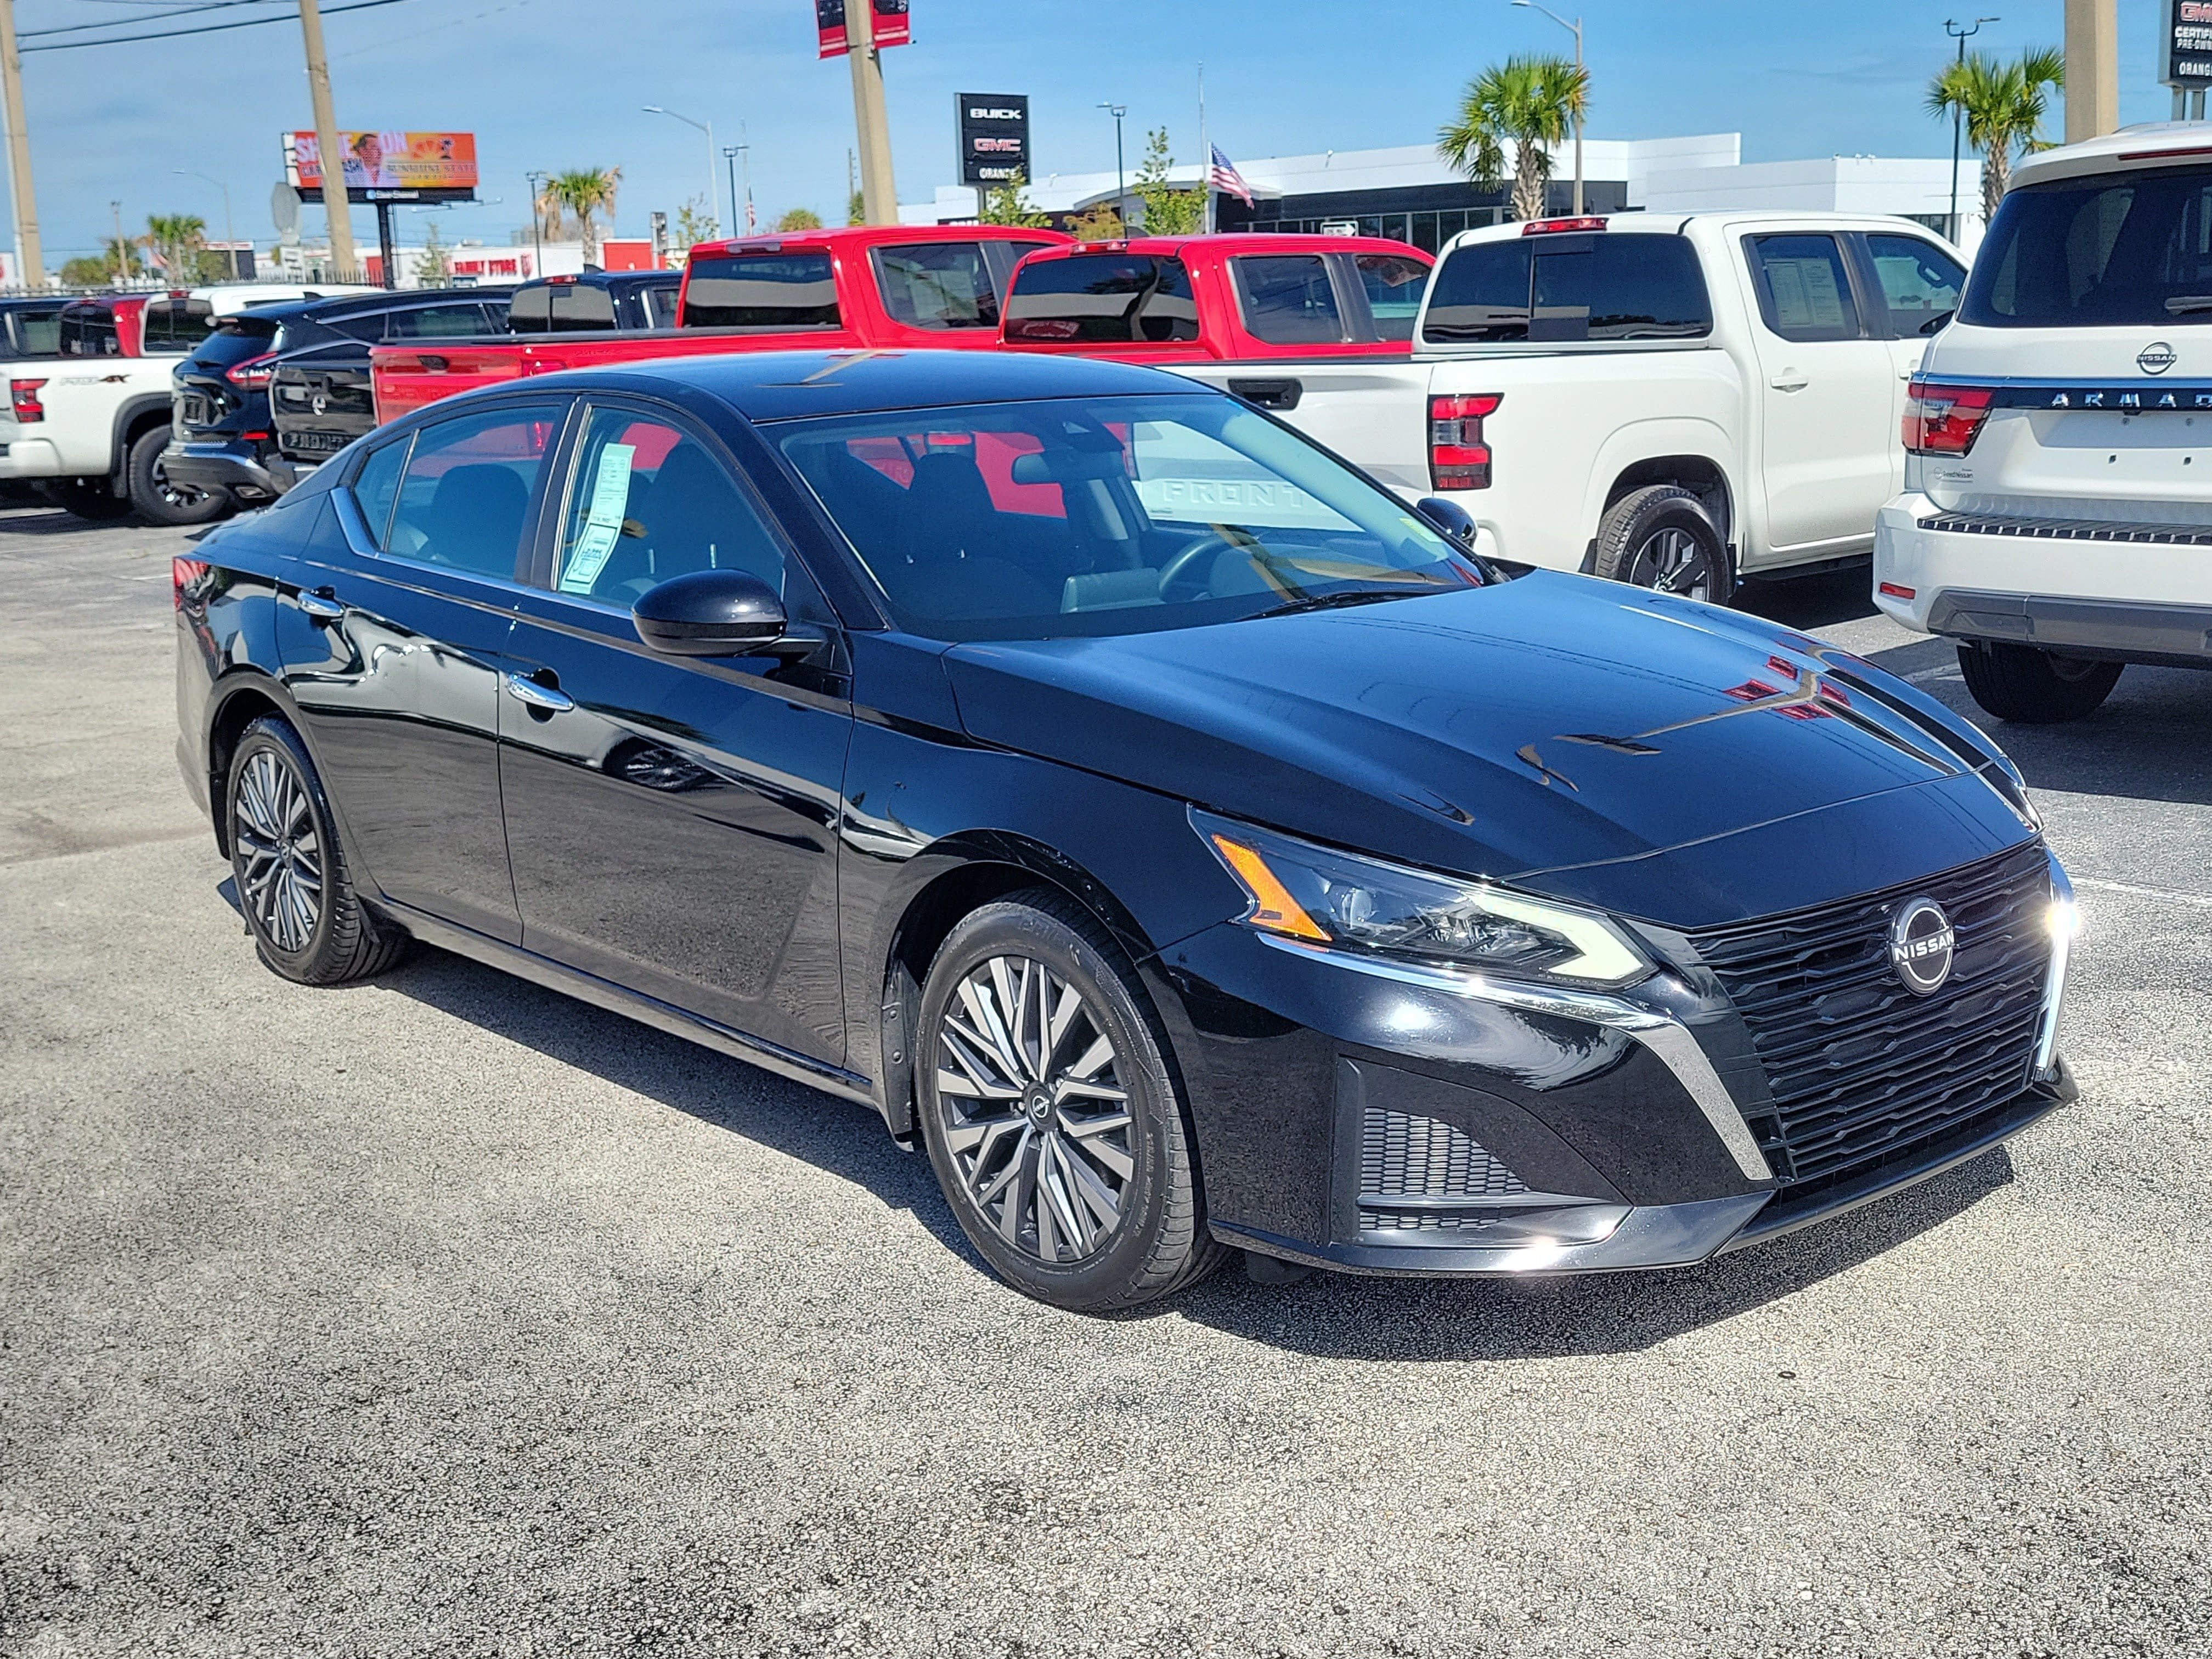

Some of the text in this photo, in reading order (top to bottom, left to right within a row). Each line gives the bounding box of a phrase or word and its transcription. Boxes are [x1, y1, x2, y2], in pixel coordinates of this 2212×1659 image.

[2180, 1, 2212, 22] GM
[2179, 61, 2212, 76] ORANG
[970, 108, 1023, 120] BUICK
[973, 138, 1022, 151] GMC
[1894, 929, 1955, 961] NISSAN
